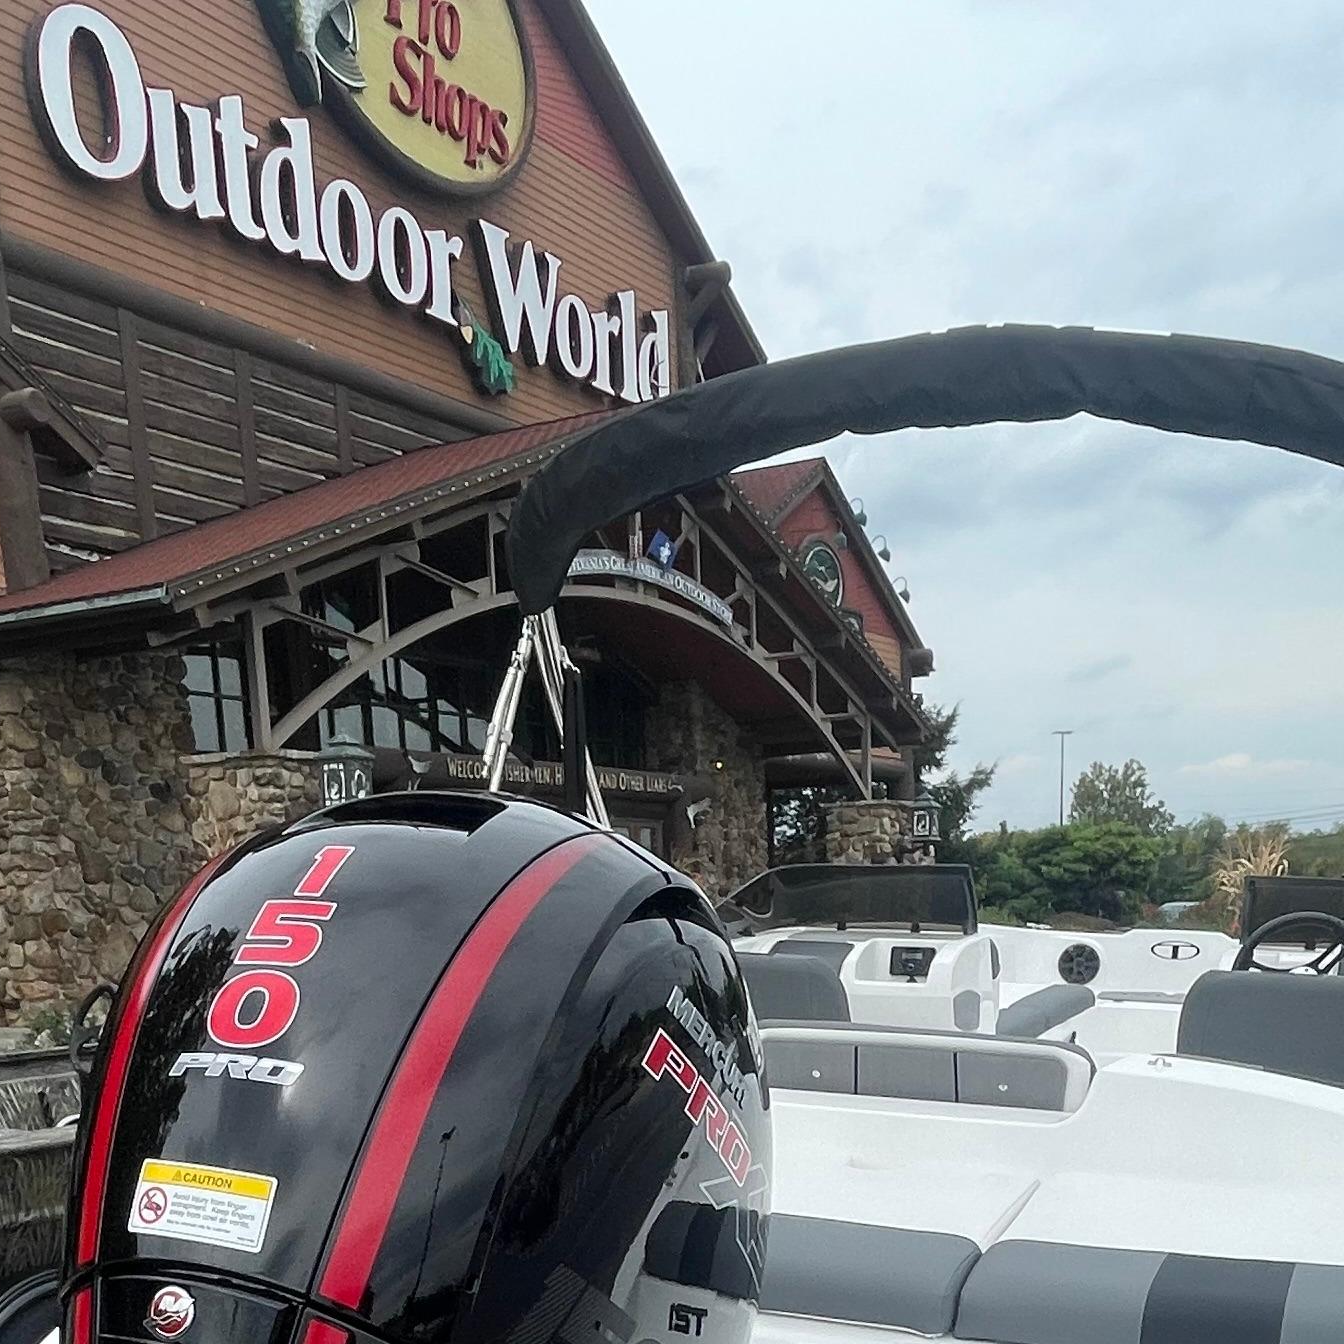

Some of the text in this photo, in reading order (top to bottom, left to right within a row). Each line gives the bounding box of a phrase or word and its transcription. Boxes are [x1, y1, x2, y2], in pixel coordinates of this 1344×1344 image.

[389, 35, 510, 169] Shops
[38, 3, 669, 403] Outdoor World
[598, 772, 617, 790] AND
[619, 772, 644, 791] OTHER
[207, 845, 355, 1049] 150
[169, 1052, 305, 1086] PRO
[642, 1028, 752, 1187] PRO
[183, 1173, 232, 1189] CAUTION
